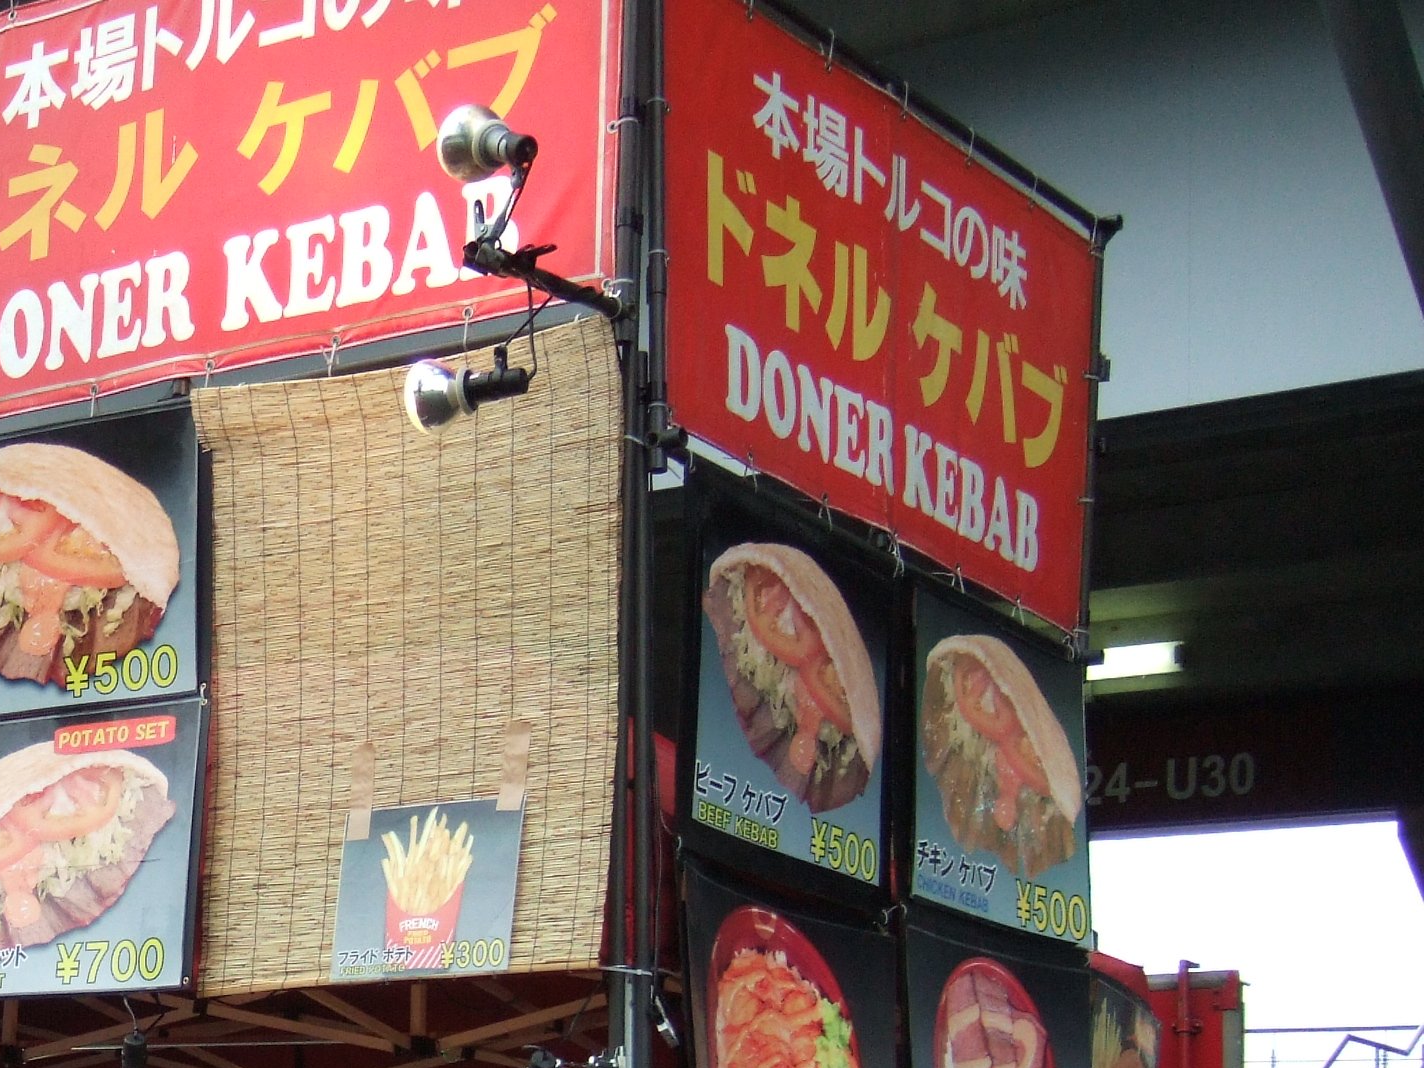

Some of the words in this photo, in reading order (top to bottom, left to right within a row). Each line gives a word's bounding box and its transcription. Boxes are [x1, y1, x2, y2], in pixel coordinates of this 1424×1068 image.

[1, 0, 460, 130] 本場トルコ
[237, 3, 558, 197] ケバブ
[752, 71, 1028, 311] 本場トルコの味
[220, 174, 521, 333] KEBAB
[706, 149, 892, 362] ドネル
[911, 281, 1069, 468] ケバブ
[724, 323, 895, 495] DONER
[903, 423, 1040, 573] KEBAB
[63, 644, 179, 699] ¥500
[58, 727, 130, 749] POTATO
[135, 720, 170, 742] SET
[694, 759, 737, 803] ビーフ
[741, 781, 789, 825] ケバブ
[697, 800, 732, 828] BEEF
[735, 811, 779, 849] KEBAB
[809, 817, 876, 881] ¥500
[916, 839, 954, 875] チキン
[958, 852, 998, 894] ケバブ
[917, 873, 954, 903] CHICKEN
[958, 886, 990, 913] KEBAB
[398, 917, 439, 933] FRENCH
[1014, 878, 1088, 940] ¥500
[55, 937, 165, 986] ¥700
[339, 966, 366, 976] FRIED
[382, 946, 414, 963] ポテト
[440, 938, 504, 969] ¥300
